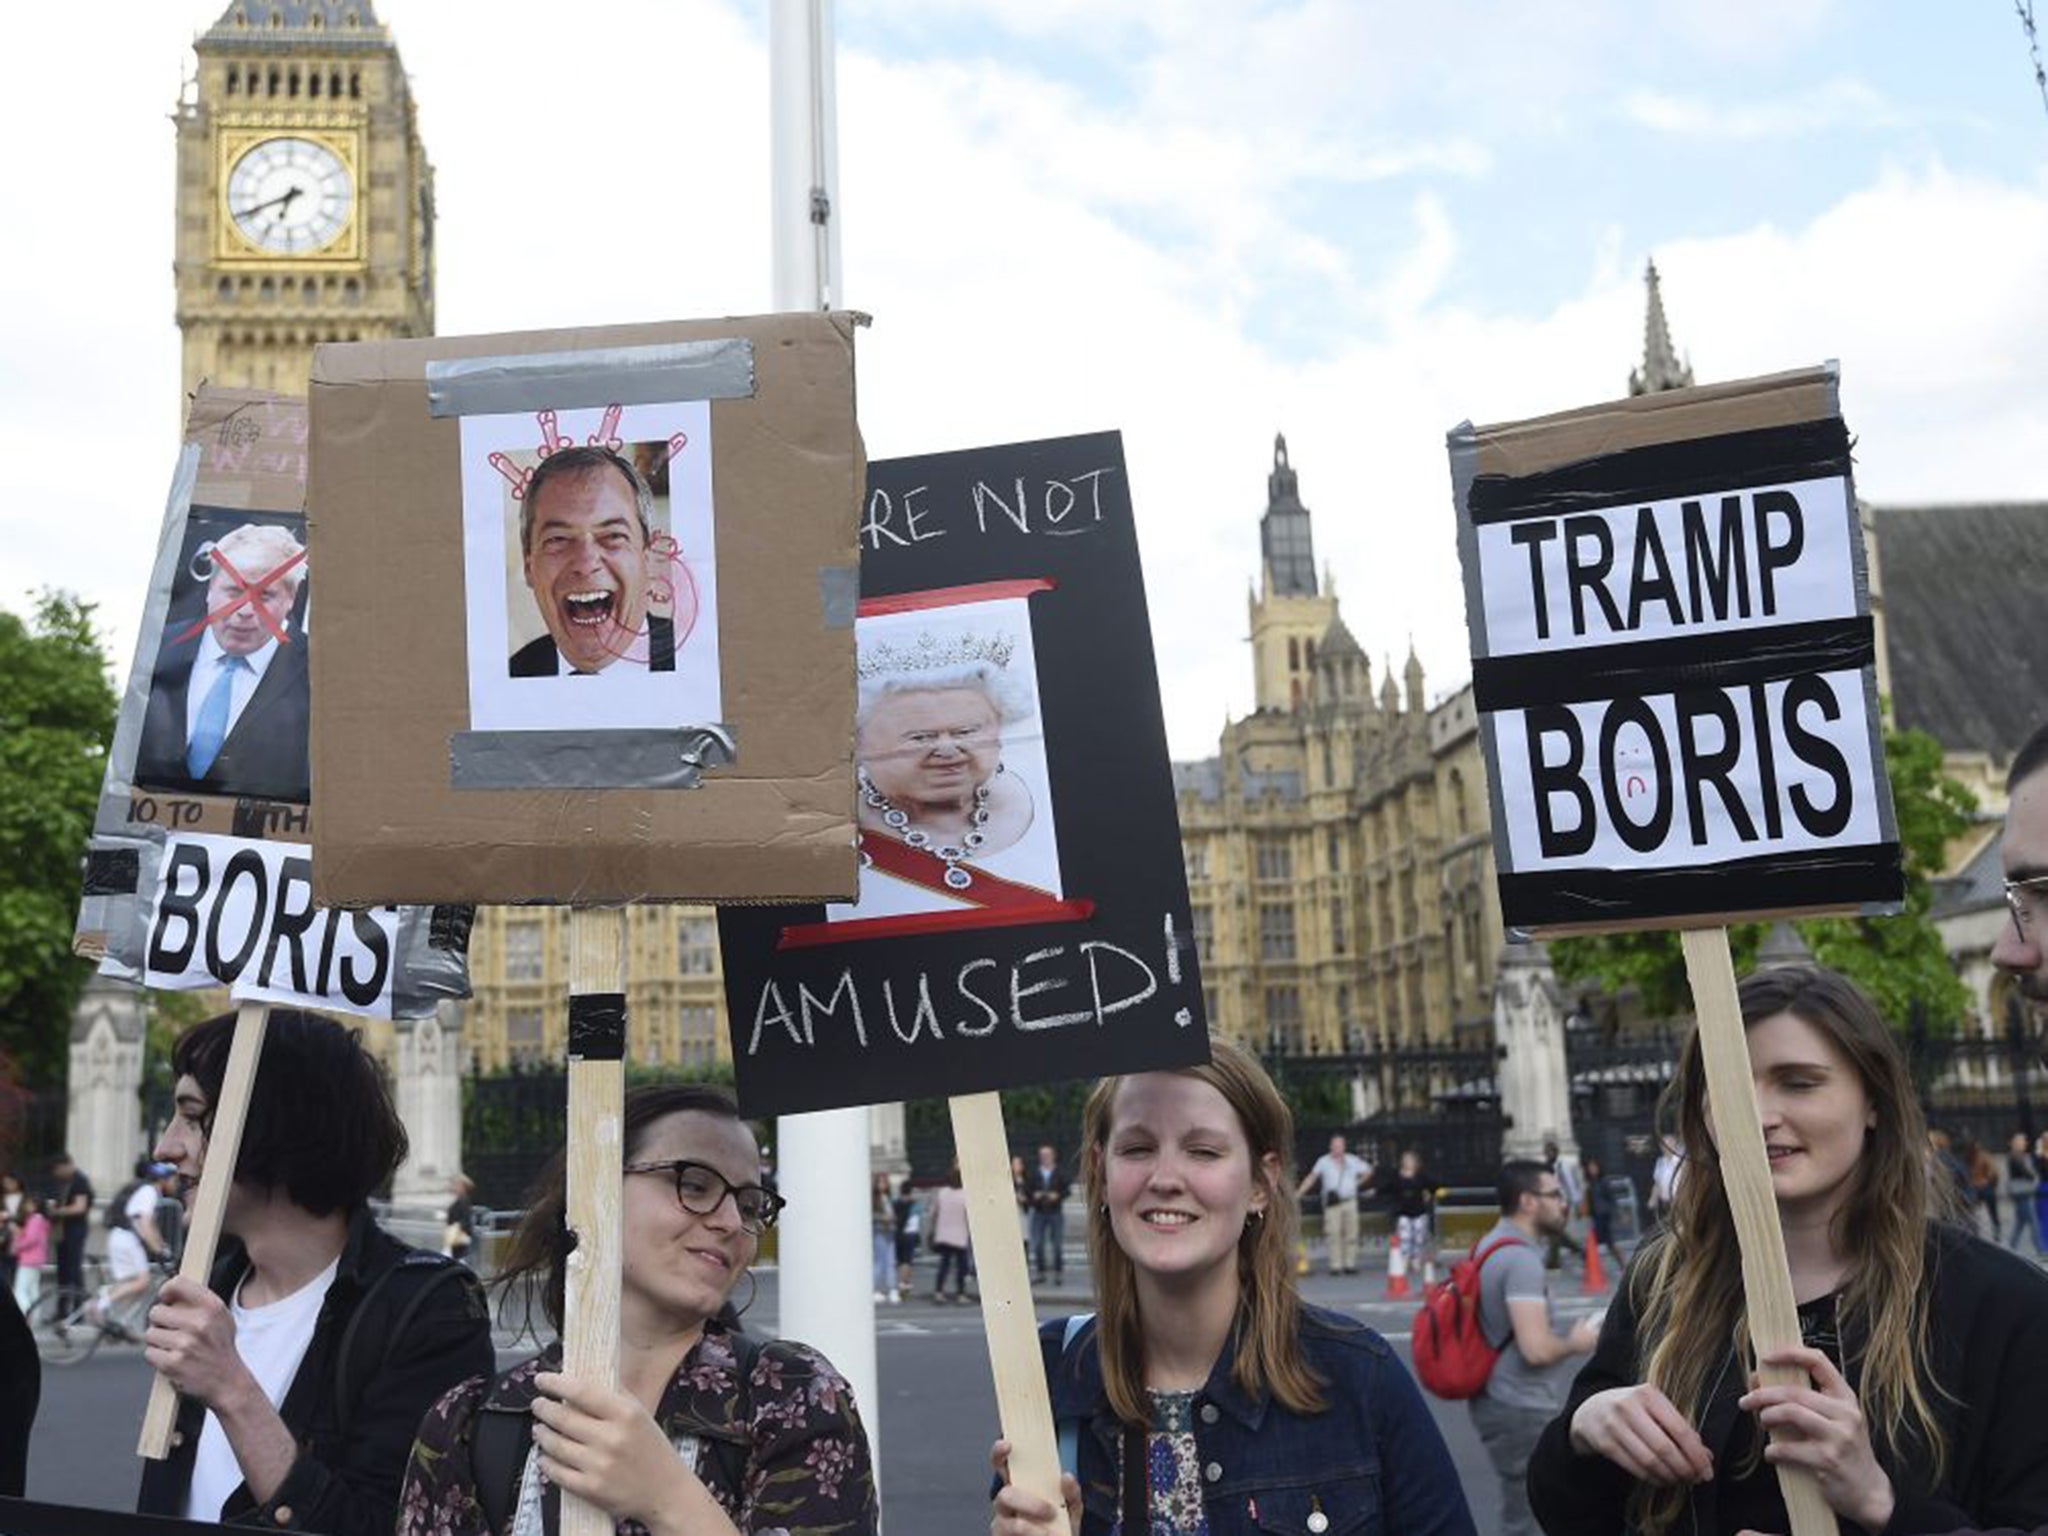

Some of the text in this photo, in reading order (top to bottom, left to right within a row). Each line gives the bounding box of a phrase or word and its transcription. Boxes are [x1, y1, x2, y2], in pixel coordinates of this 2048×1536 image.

[860, 466, 1117, 549] RE NOT
[1510, 490, 1805, 639] TRAMP
[165, 800, 204, 829] TO
[1524, 673, 1853, 859] BORIS
[149, 843, 390, 1006] BORIS
[748, 912, 1194, 1055] AMUSED!
